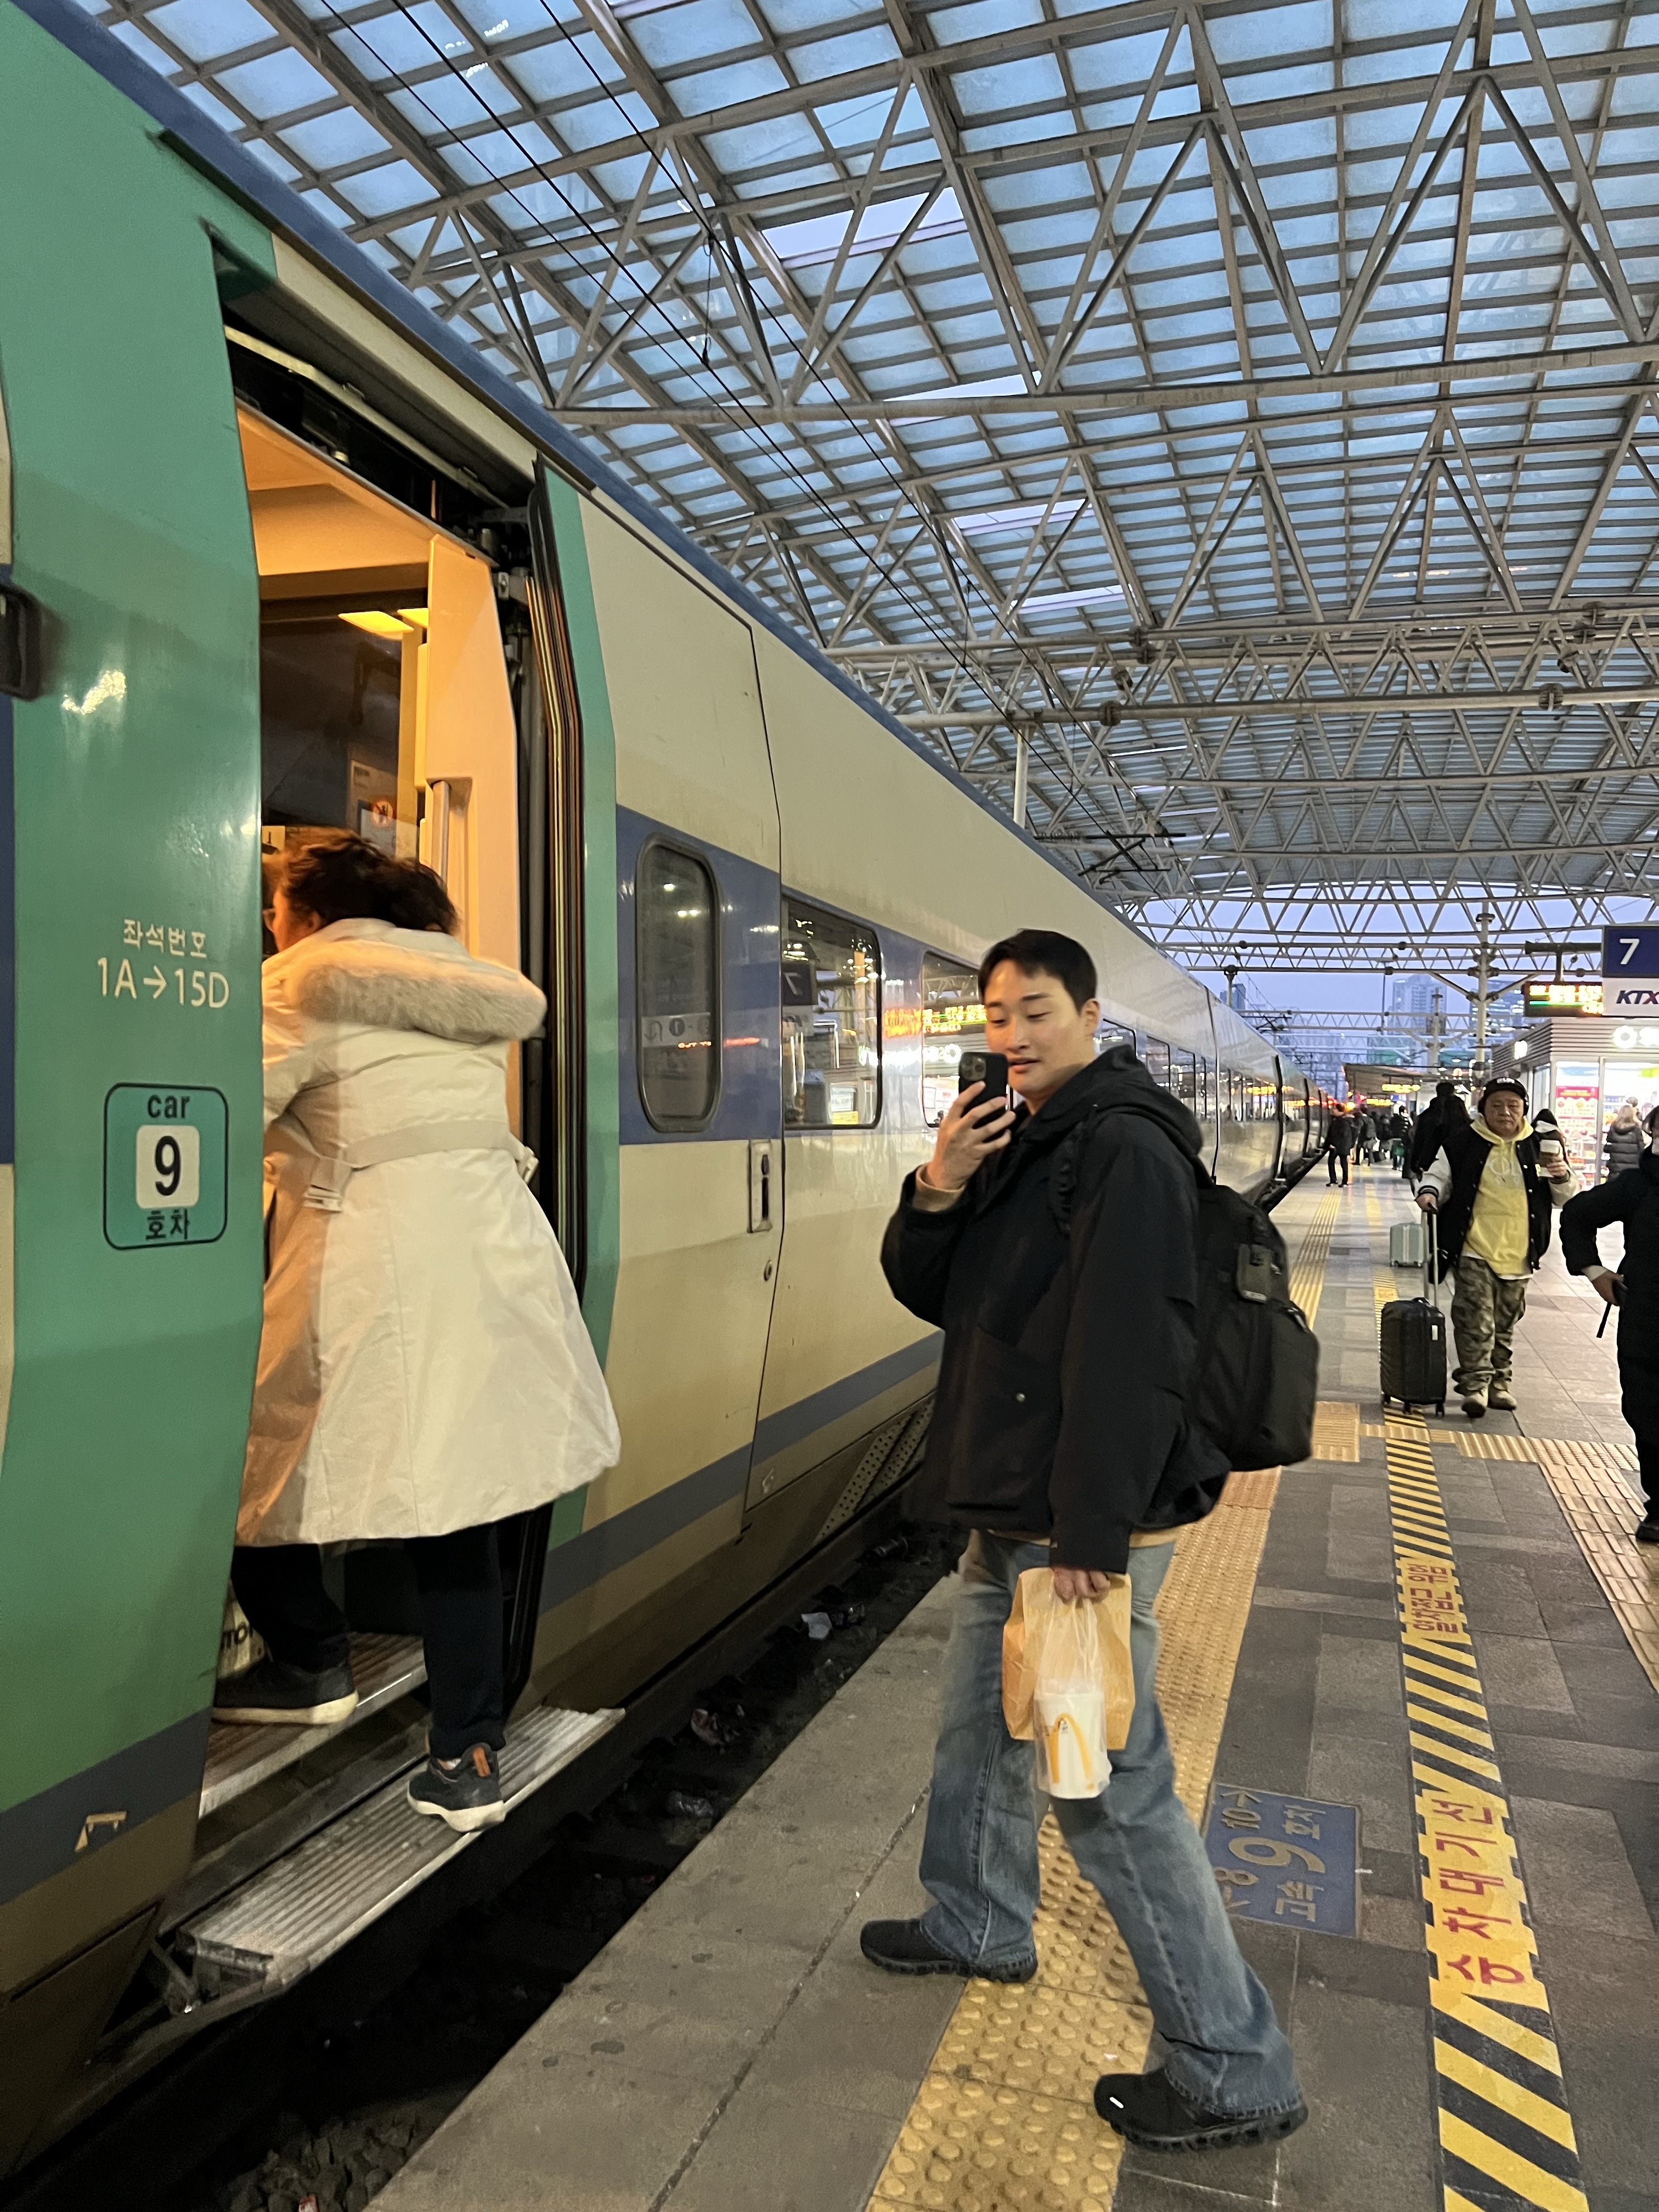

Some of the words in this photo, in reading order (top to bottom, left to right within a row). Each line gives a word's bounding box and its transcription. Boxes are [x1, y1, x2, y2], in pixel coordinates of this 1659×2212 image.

[123, 918, 207, 958] 좌석번호
[1620, 938, 1639, 964] 7
[97, 957, 137, 1000] 1A
[174, 968, 229, 1008] 15D
[1616, 990, 1659, 1005] KTX
[147, 1094, 190, 1119] car
[154, 1135, 181, 1196] 9
[145, 1207, 190, 1242] 호차
[1407, 1562, 1448, 1584] 위험
[1410, 1587, 1458, 1633] 열차접근
[1222, 1807, 1261, 1829] 10
[1283, 1804, 1327, 1839] 호차
[1228, 1836, 1326, 1874] 9
[1274, 1880, 1325, 1922] 고속
[1431, 1798, 1526, 1985] 승차대기선
